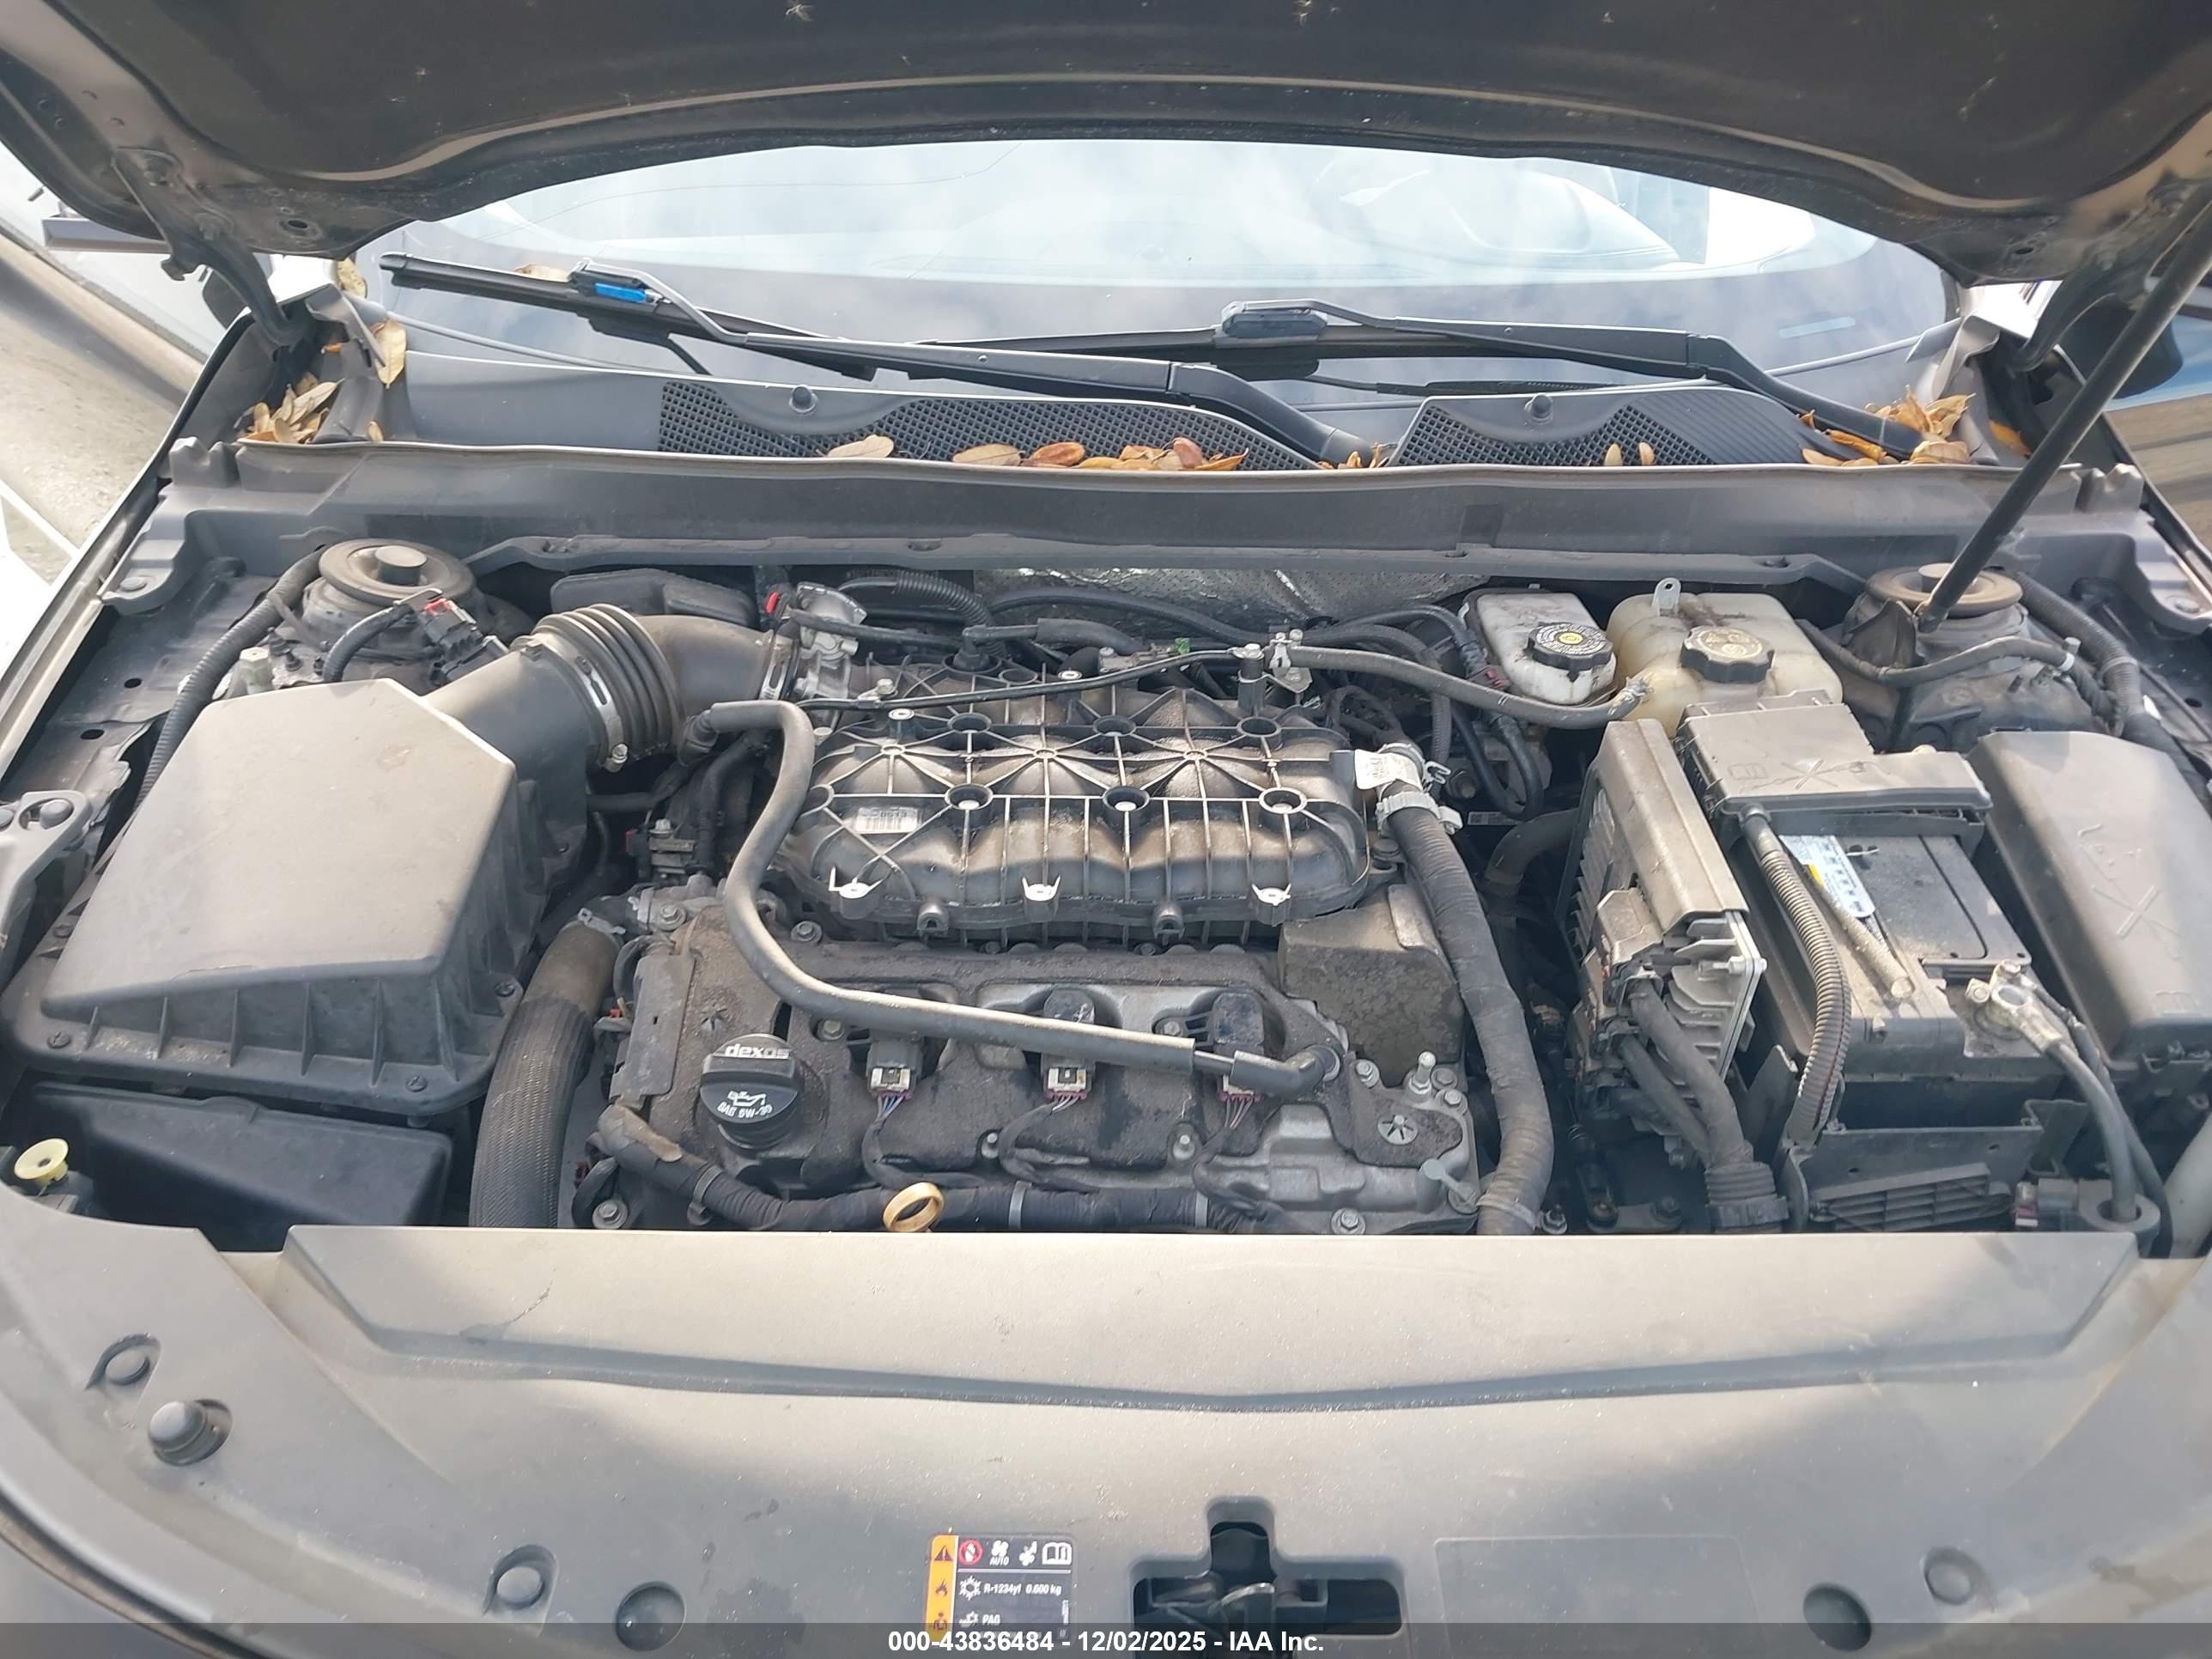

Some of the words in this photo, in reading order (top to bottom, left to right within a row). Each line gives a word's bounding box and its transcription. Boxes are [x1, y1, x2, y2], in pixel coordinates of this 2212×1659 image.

[726, 1043, 790, 1059] dexos
[989, 1557, 1010, 1566] AUTO
[1050, 1583, 1062, 1596] kg
[981, 1613, 1001, 1625] PAG
